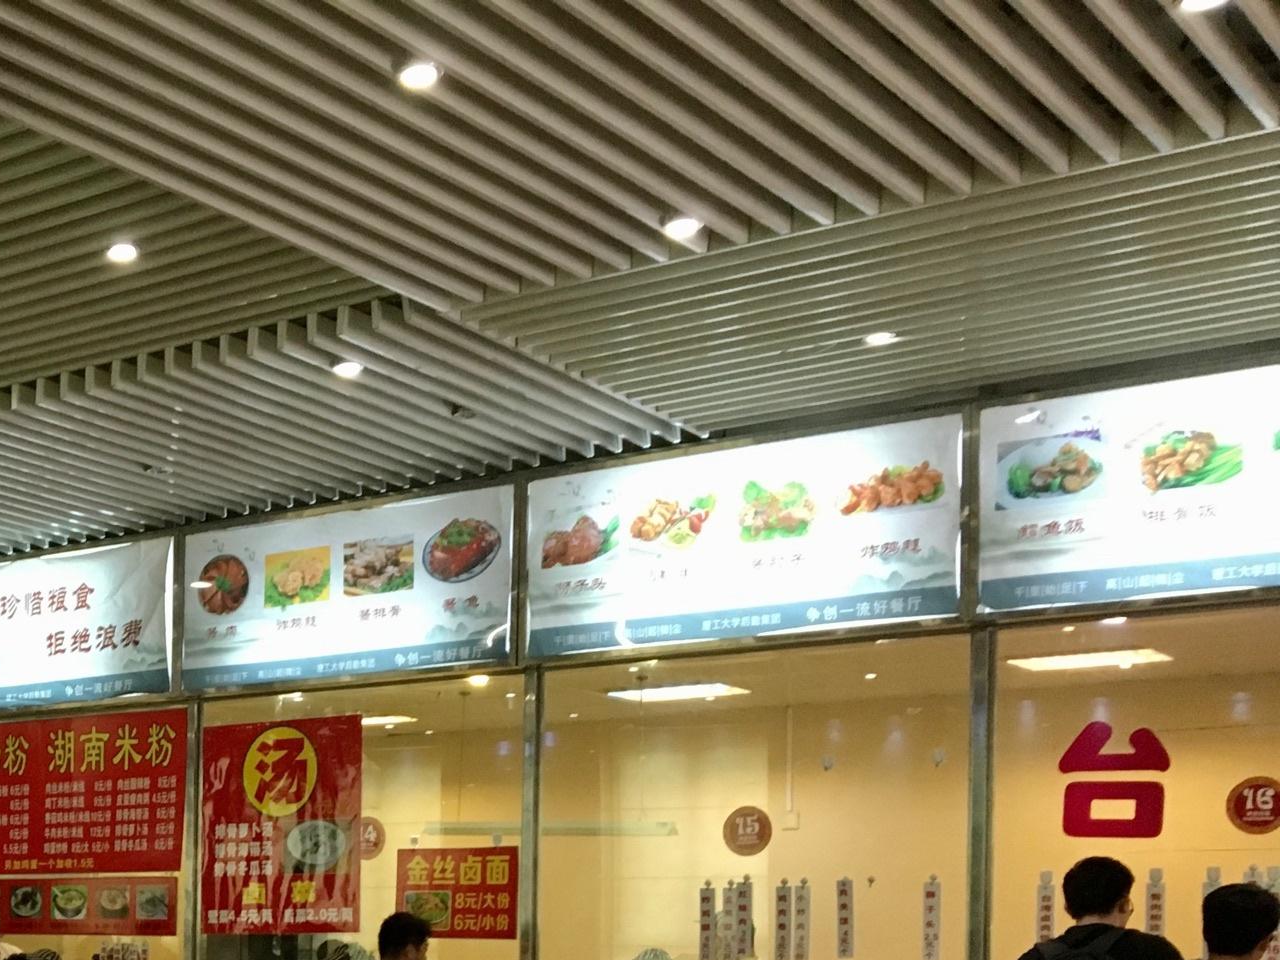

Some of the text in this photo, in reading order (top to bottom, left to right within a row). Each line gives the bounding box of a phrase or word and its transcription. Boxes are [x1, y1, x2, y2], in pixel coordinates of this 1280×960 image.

[0, 582, 95, 620] 珍惜粮食
[806, 596, 923, 622] 争创一流好餐厅
[46, 619, 144, 657] 拒绝浪费
[394, 646, 483, 667] 争创一流好餐厅
[47, 723, 176, 773] 湖南米粉
[254, 737, 308, 804] 汤
[1058, 721, 1171, 839] 台
[1243, 787, 1276, 810] 16
[736, 815, 760, 835] 15
[407, 855, 510, 885] 金丝卤面
[455, 892, 510, 910] 8元/大份
[454, 914, 509, 931] 6元/小份
